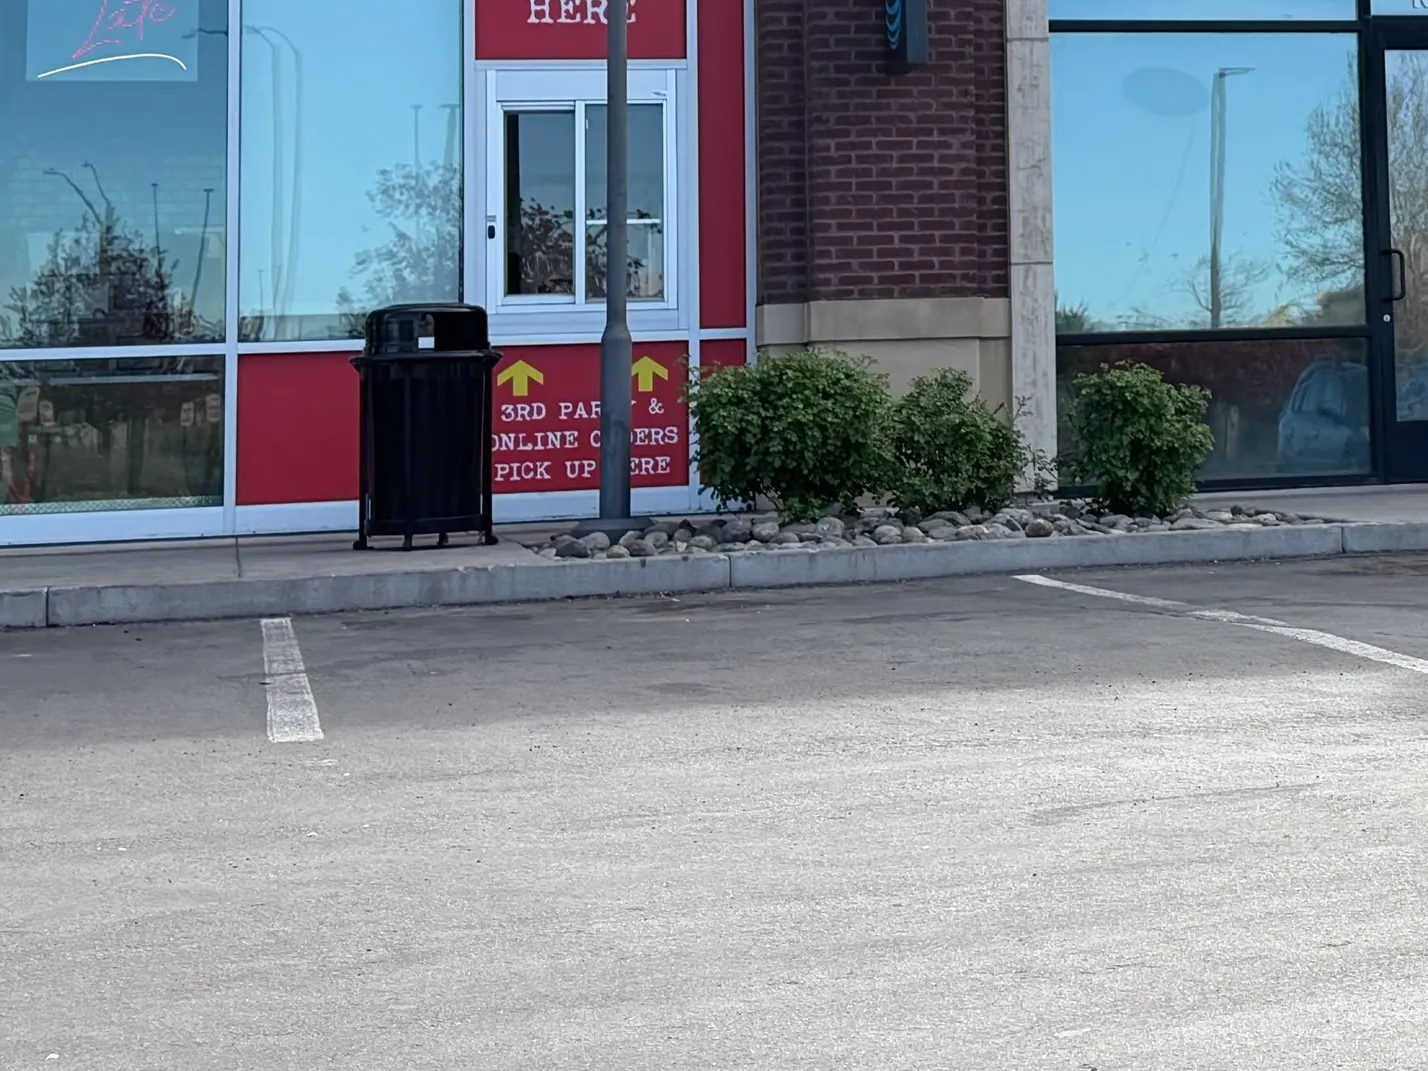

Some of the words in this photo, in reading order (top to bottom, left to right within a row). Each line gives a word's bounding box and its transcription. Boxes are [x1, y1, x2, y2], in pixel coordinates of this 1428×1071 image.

[501, 402, 546, 422] 3RD
[559, 400, 636, 420] PAR
[649, 397, 665, 414] &
[590, 426, 679, 449] OERS
[494, 461, 552, 481] PICK
[565, 460, 596, 478] UP
[629, 456, 671, 475] ERE
